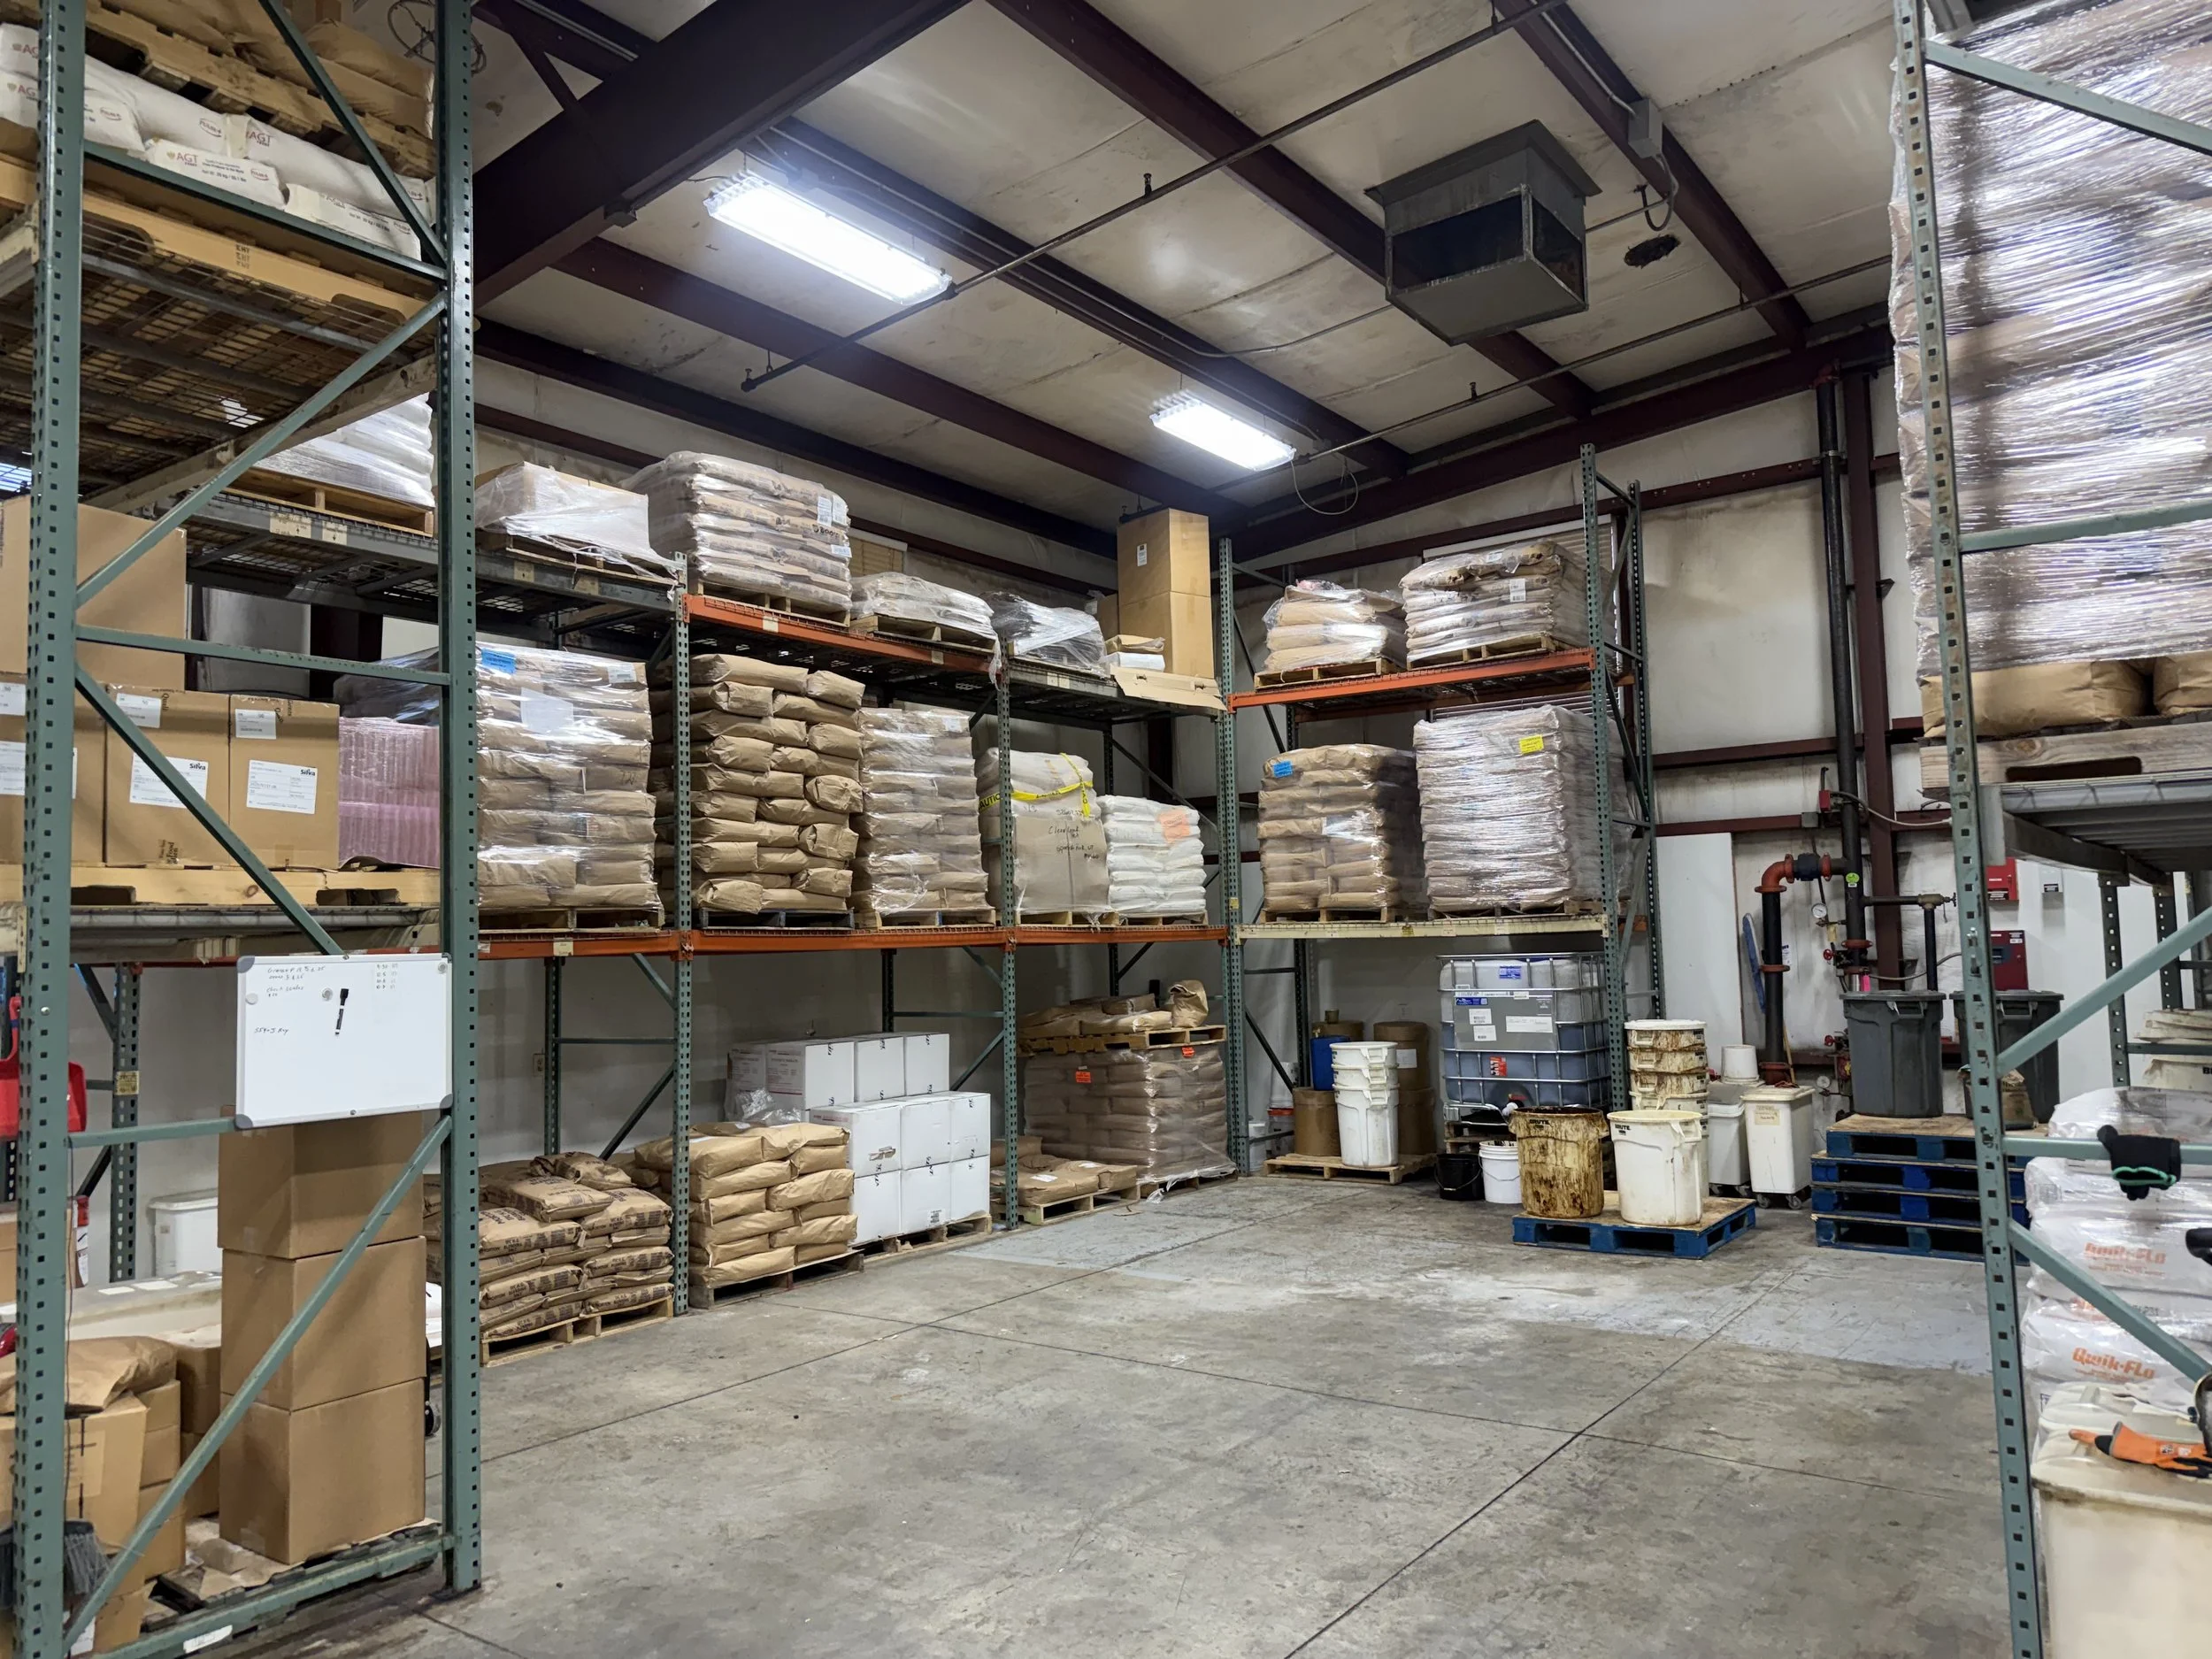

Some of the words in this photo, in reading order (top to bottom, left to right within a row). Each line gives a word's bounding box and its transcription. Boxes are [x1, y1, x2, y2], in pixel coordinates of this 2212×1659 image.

[249, 131, 274, 143] AGT
[177, 152, 198, 164] AGT
[189, 762, 206, 771] Silva
